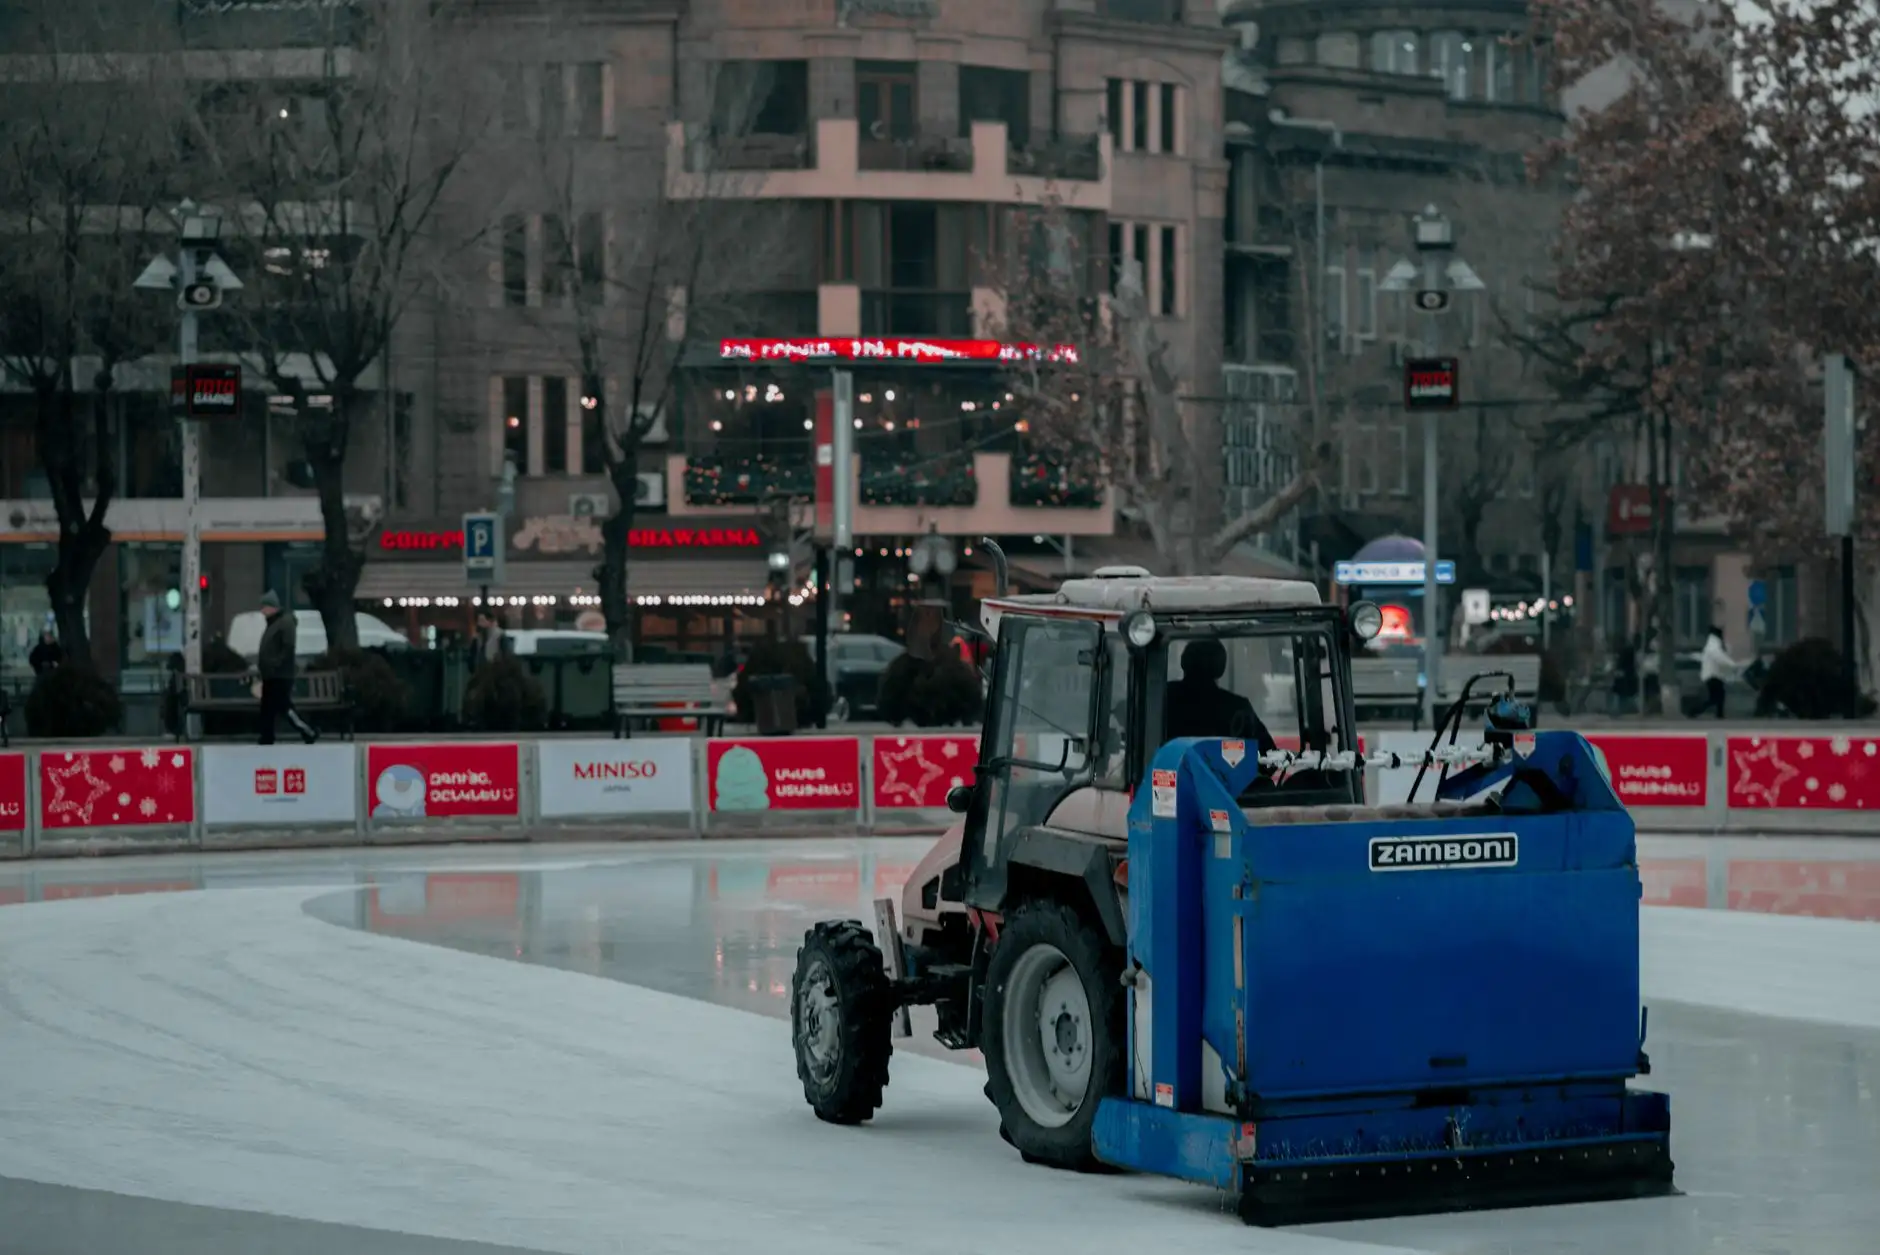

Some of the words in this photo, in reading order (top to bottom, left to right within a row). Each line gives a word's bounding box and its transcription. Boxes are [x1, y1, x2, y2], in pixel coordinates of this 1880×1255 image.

[195, 377, 235, 394] TOTO
[469, 528, 488, 556] P
[627, 527, 761, 547] SHAWARMA
[573, 760, 658, 779] MINISO
[1377, 840, 1510, 864] ZAMBONI
